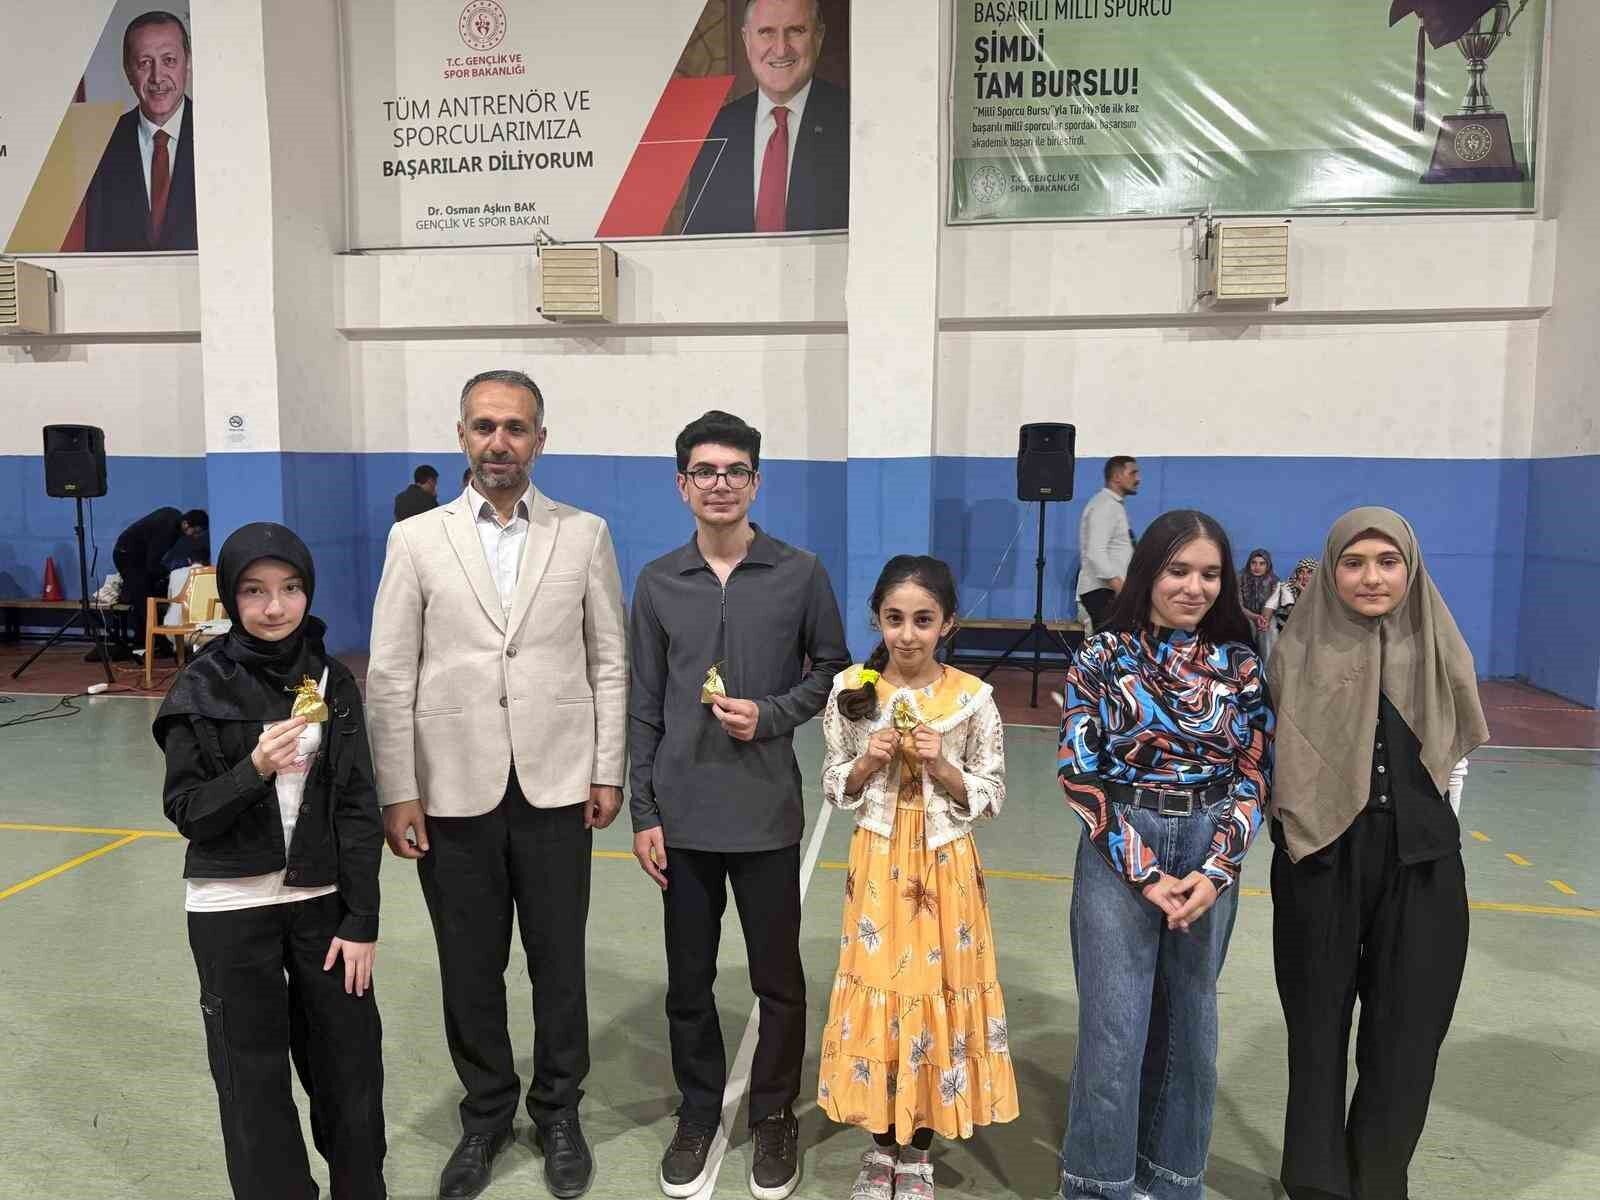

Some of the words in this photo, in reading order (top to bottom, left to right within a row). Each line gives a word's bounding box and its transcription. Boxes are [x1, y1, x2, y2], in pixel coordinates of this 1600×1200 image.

[1104, 0, 1172, 17] SPORCU
[974, 28, 1044, 70] ŞİMDİ
[446, 57, 464, 67] T.C.
[465, 53, 507, 67] GENÇLİK
[508, 54, 522, 63] VE
[443, 69, 470, 79] SPOR
[471, 65, 526, 78] BAKANLIĞI
[974, 71, 1024, 99] TAM
[1031, 67, 1139, 98] BURSLU!
[383, 97, 430, 121] TÜM
[437, 90, 557, 119] ANTRENÖR
[563, 90, 591, 112] VE
[997, 105, 1025, 118] Sporcu
[393, 118, 582, 148] SPORCULARIMIZA
[383, 156, 483, 180] BAŞARILAR
[488, 149, 594, 172] DİLİYORUM
[1069, 173, 1080, 182] VE
[427, 206, 443, 217] Dr.
[445, 204, 481, 216] Osman
[483, 203, 511, 216] Aşkın
[514, 202, 536, 213] BAK
[415, 216, 460, 231] GENÇLİK
[462, 218, 475, 228] VE
[477, 216, 507, 228] SPOR
[509, 214, 550, 226] BAKANI
